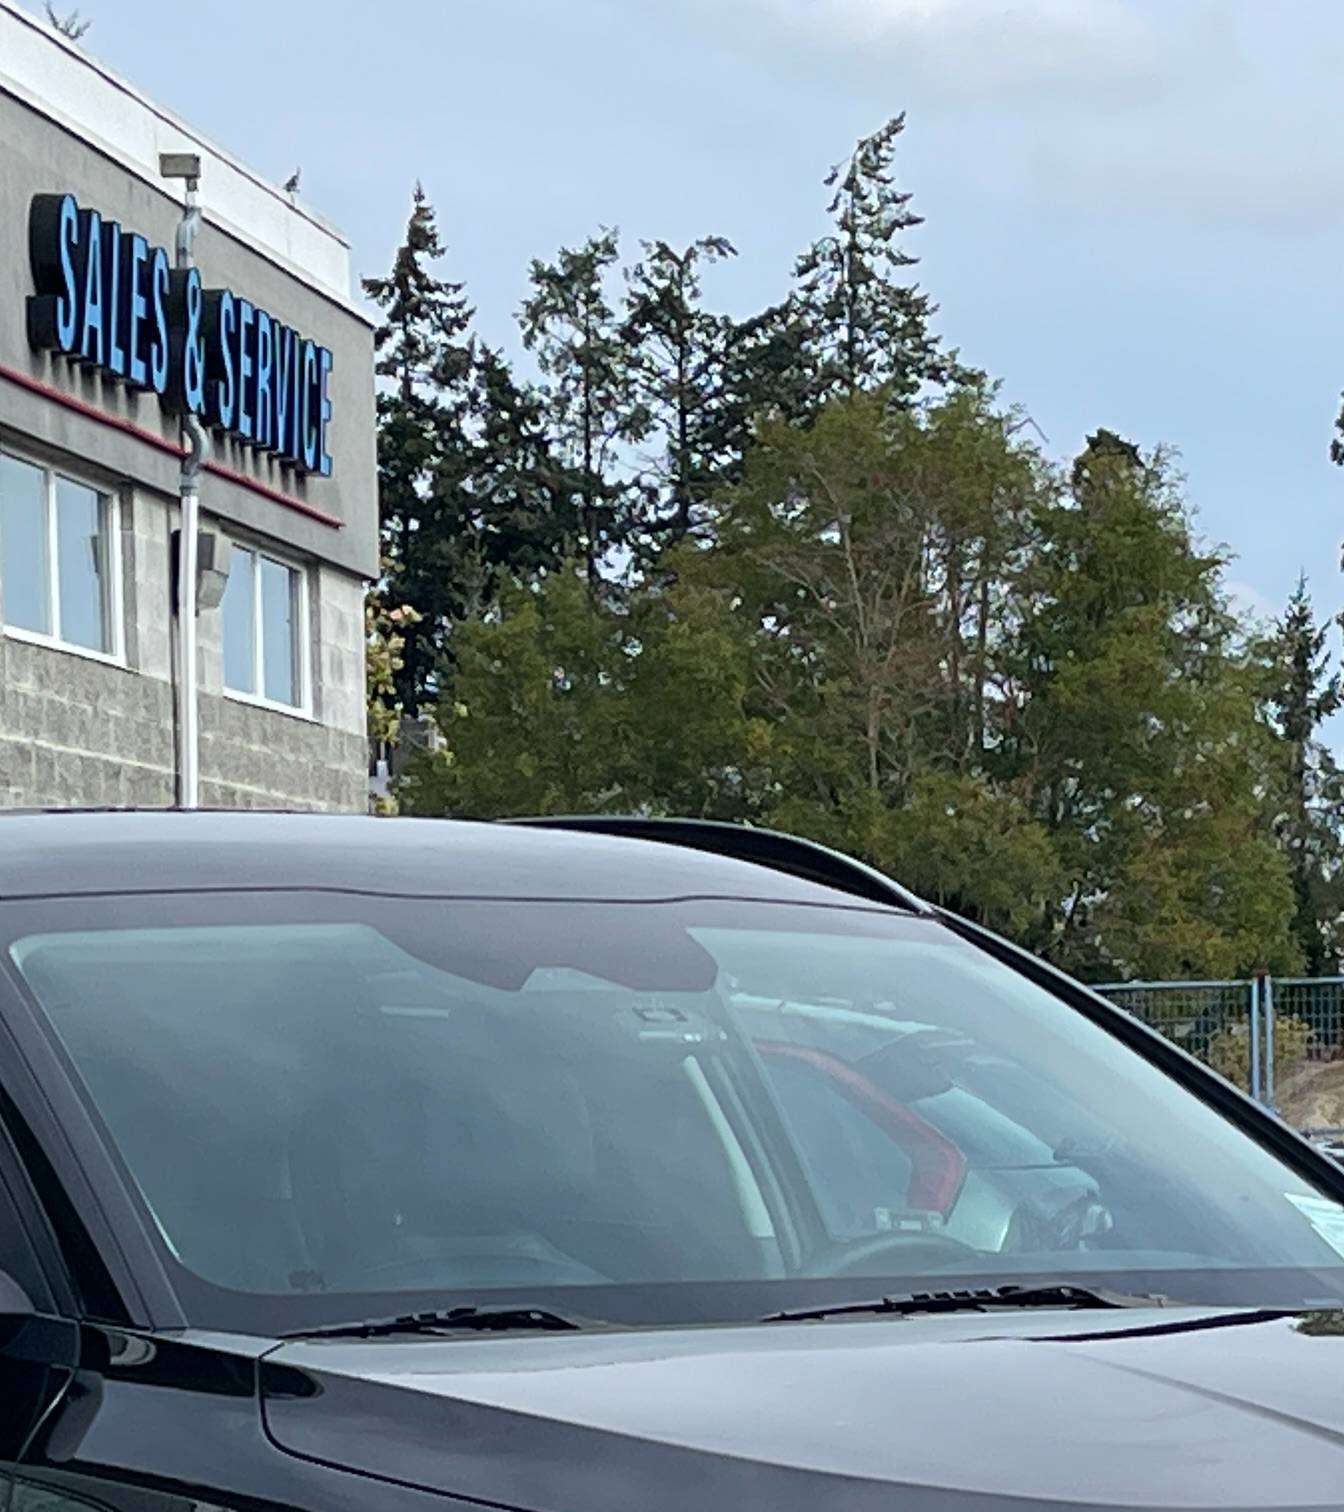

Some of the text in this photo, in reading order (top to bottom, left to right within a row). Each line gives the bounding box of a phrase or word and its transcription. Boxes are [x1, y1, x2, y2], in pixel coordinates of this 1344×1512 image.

[54, 192, 334, 478] SALES & SERVICE
